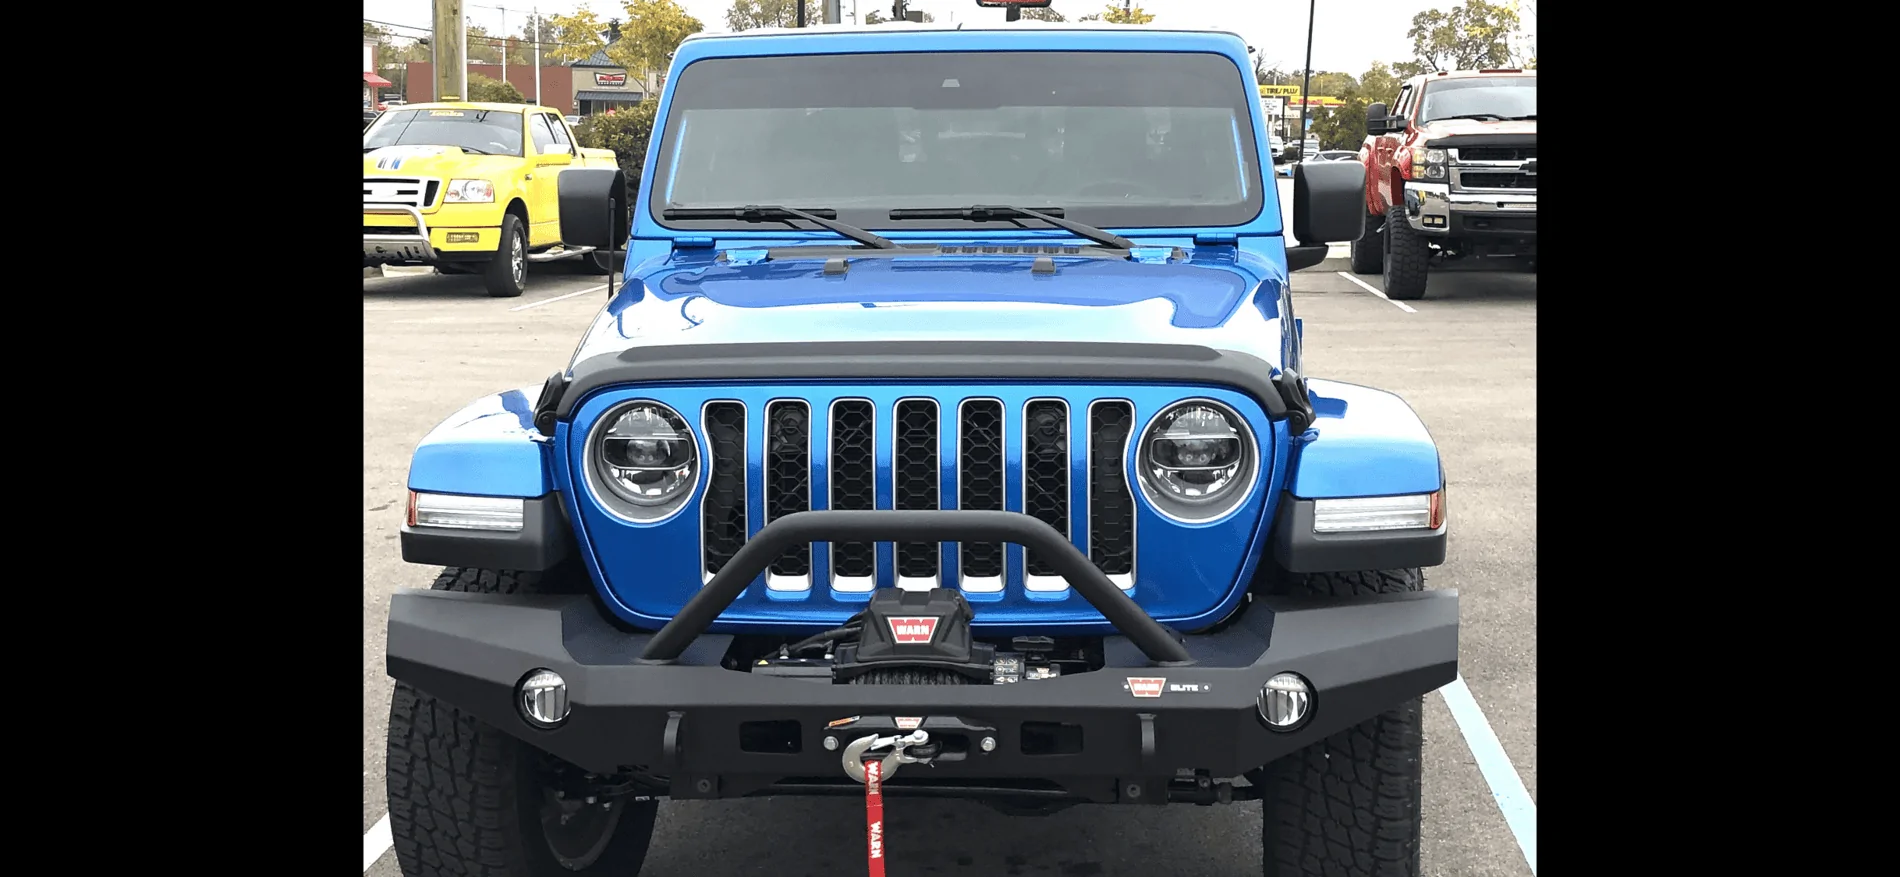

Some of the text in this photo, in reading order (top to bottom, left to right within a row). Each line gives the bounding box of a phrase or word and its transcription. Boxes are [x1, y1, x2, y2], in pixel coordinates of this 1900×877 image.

[896, 625, 930, 635] WARN
[1170, 684, 1199, 692] ELITE
[870, 821, 883, 859] WARN
